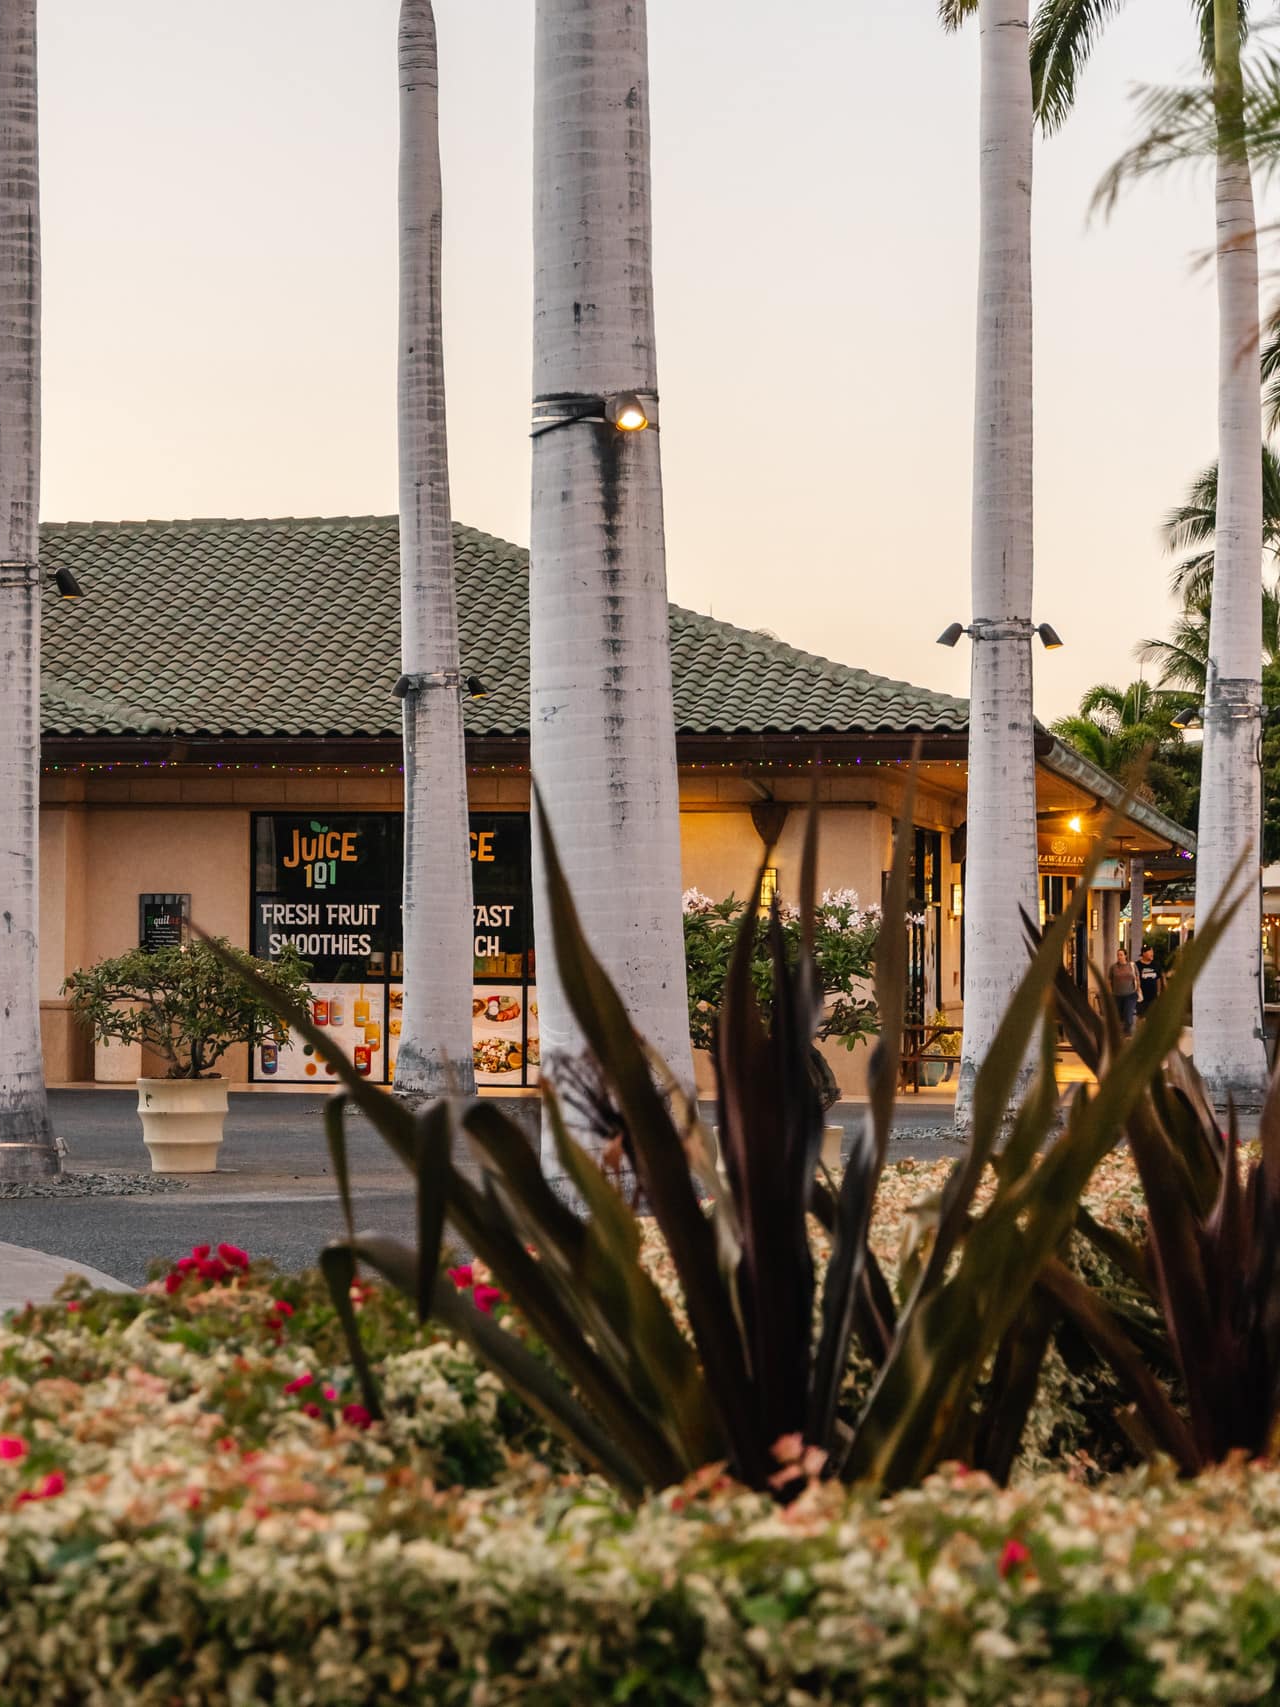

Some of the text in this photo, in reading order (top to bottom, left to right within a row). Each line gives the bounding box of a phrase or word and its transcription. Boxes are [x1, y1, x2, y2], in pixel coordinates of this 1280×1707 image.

[283, 829, 358, 868] JUICE
[304, 860, 337, 889] 101
[261, 904, 320, 925] FRESH
